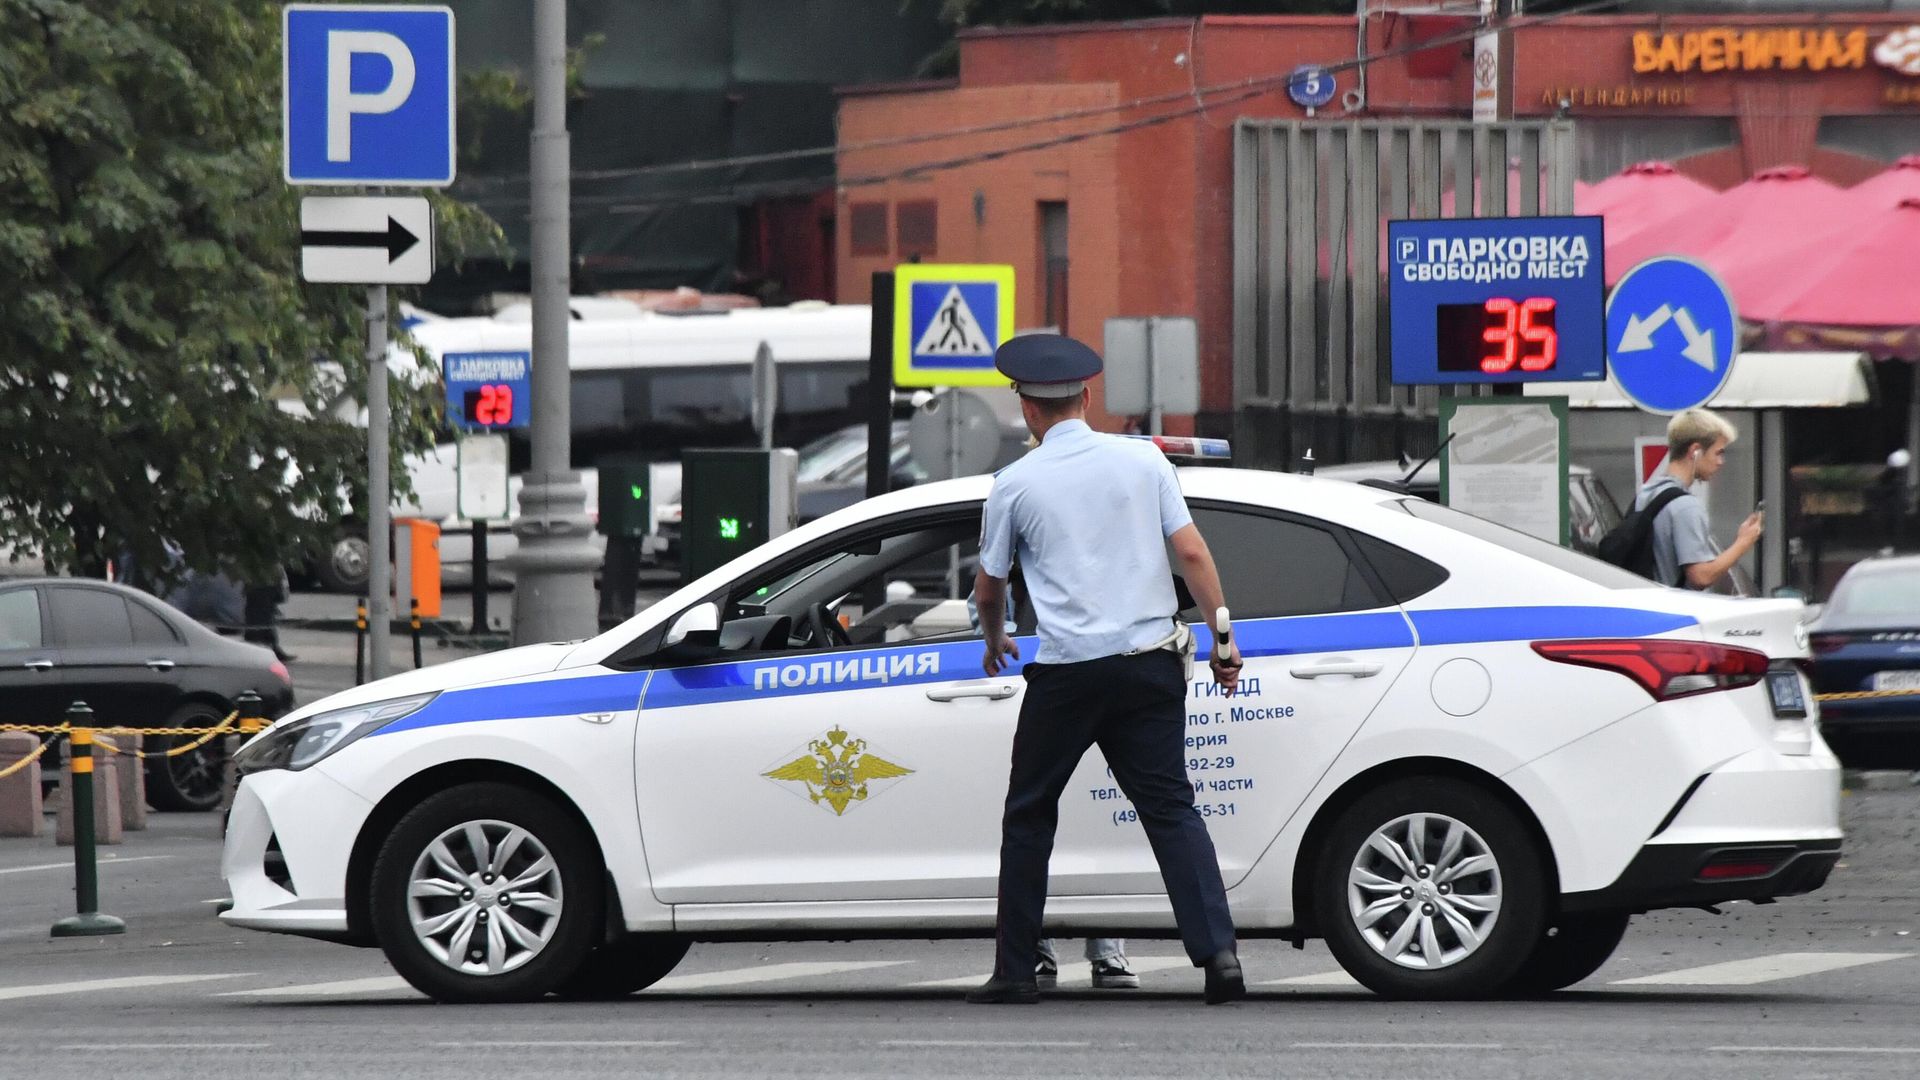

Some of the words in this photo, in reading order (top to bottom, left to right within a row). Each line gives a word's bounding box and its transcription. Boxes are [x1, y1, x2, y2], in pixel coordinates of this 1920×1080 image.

[1632, 26, 1867, 73] ВАРЕНИЧНАЯ
[327, 30, 415, 162] P
[1305, 71, 1320, 95] 5
[1427, 235, 1590, 263] ПАРКОВКА
[1403, 262, 1521, 283] СВОБОДНО
[1527, 260, 1588, 279] МЕСТ
[1480, 297, 1558, 374] 35
[475, 383, 513, 426] 23
[754, 652, 941, 690] ПОЛИЦИЯ
[1188, 713, 1209, 726] по
[1215, 712, 1225, 724] г.
[1230, 704, 1295, 722] Москве
[1184, 756, 1235, 770] -92-29
[1090, 788, 1122, 801] тел.
[1209, 778, 1254, 792] части
